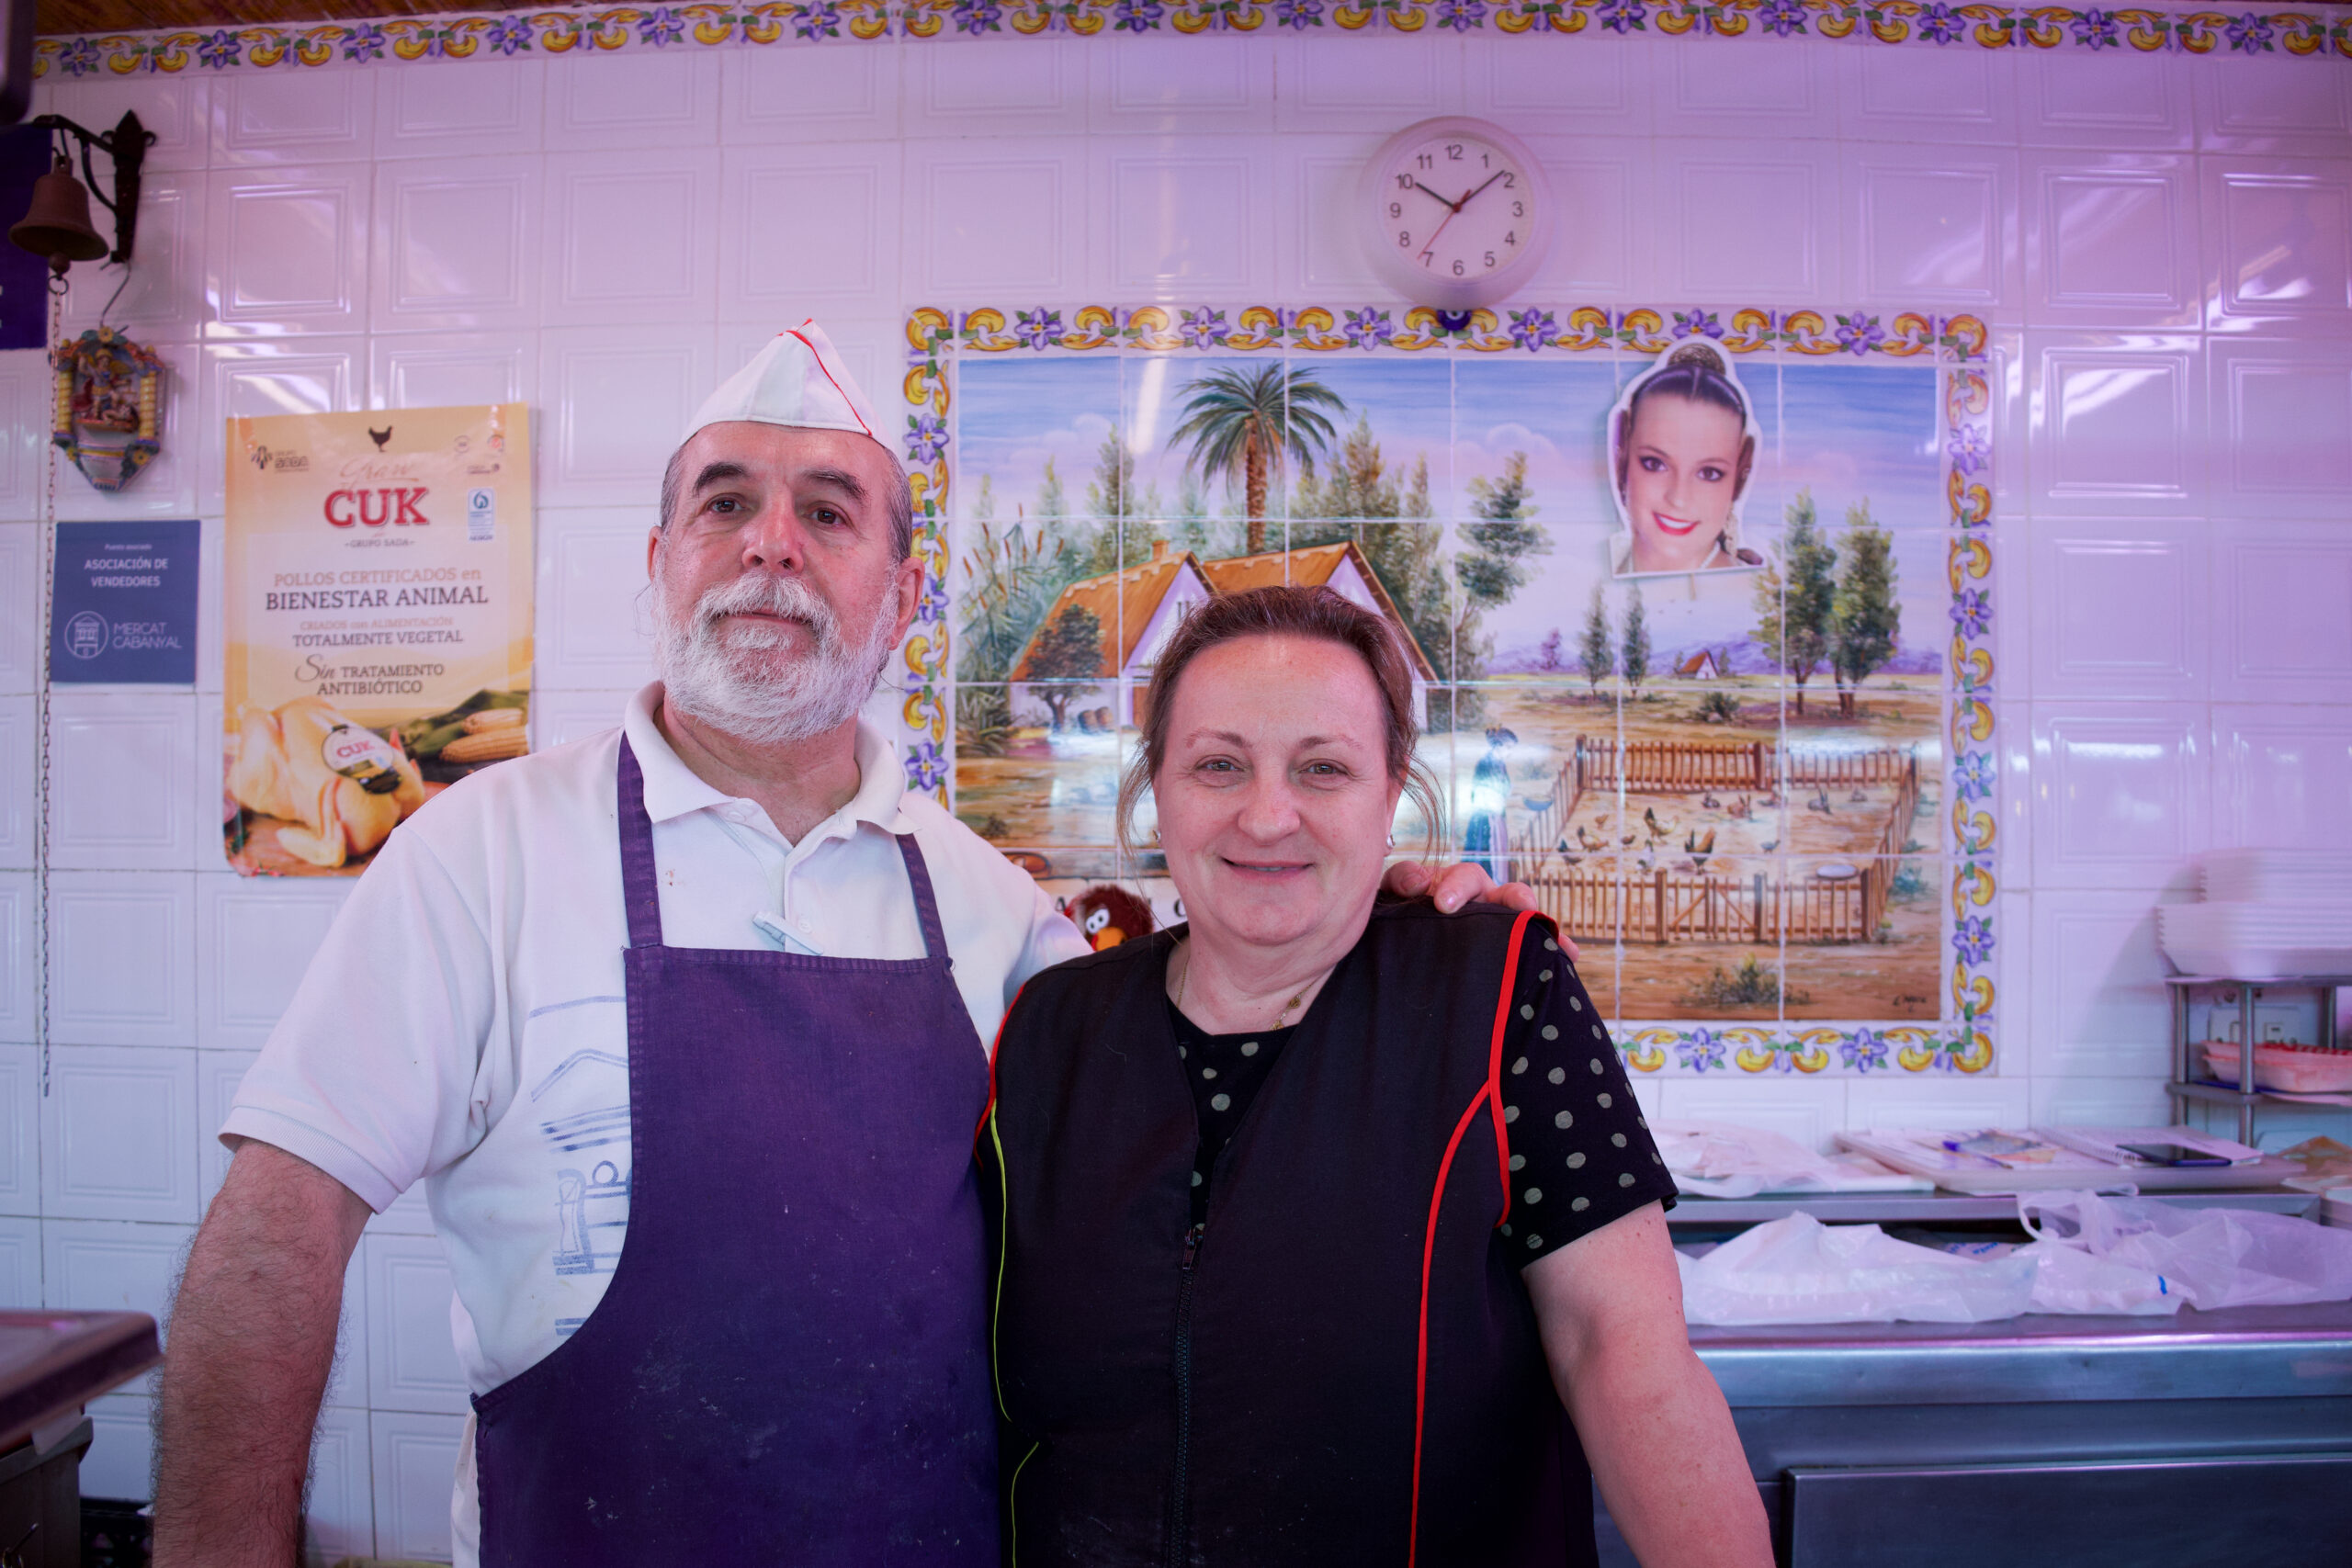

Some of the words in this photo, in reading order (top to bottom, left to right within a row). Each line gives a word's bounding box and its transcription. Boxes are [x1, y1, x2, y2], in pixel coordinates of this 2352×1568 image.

[1444, 143, 1464, 161] 12
[1416, 154, 1433, 169] 11
[1480, 152, 1489, 169] 1
[1395, 173, 1414, 189] 10
[1503, 171, 1515, 188] 2
[1389, 202, 1402, 219] 9
[1512, 200, 1524, 218] 3
[1398, 231, 1411, 247] 8
[1504, 231, 1516, 246] 4
[1423, 251, 1434, 267] 7
[1484, 251, 1496, 267] 5
[1453, 259, 1464, 276] 6
[324, 487, 430, 528] CUK
[84, 556, 152, 570] ASOCIACIÓN
[154, 558, 168, 570] DE
[91, 576, 161, 588] VENDEDORES
[274, 571, 335, 588] POLLOS
[339, 568, 458, 584] CERTIFICADOS
[461, 569, 481, 581] en
[266, 589, 389, 611] BIENESTAR
[395, 585, 490, 606] ANIMAL
[113, 622, 167, 635] MERCAT
[113, 637, 183, 649] CABANYAL
[292, 631, 393, 647] TOTALMENTE
[397, 629, 463, 644] VEGETAL
[294, 653, 336, 682] Sin
[340, 663, 445, 678] TRATAMIENTO
[317, 679, 424, 695] ANTIBIÓTICO
